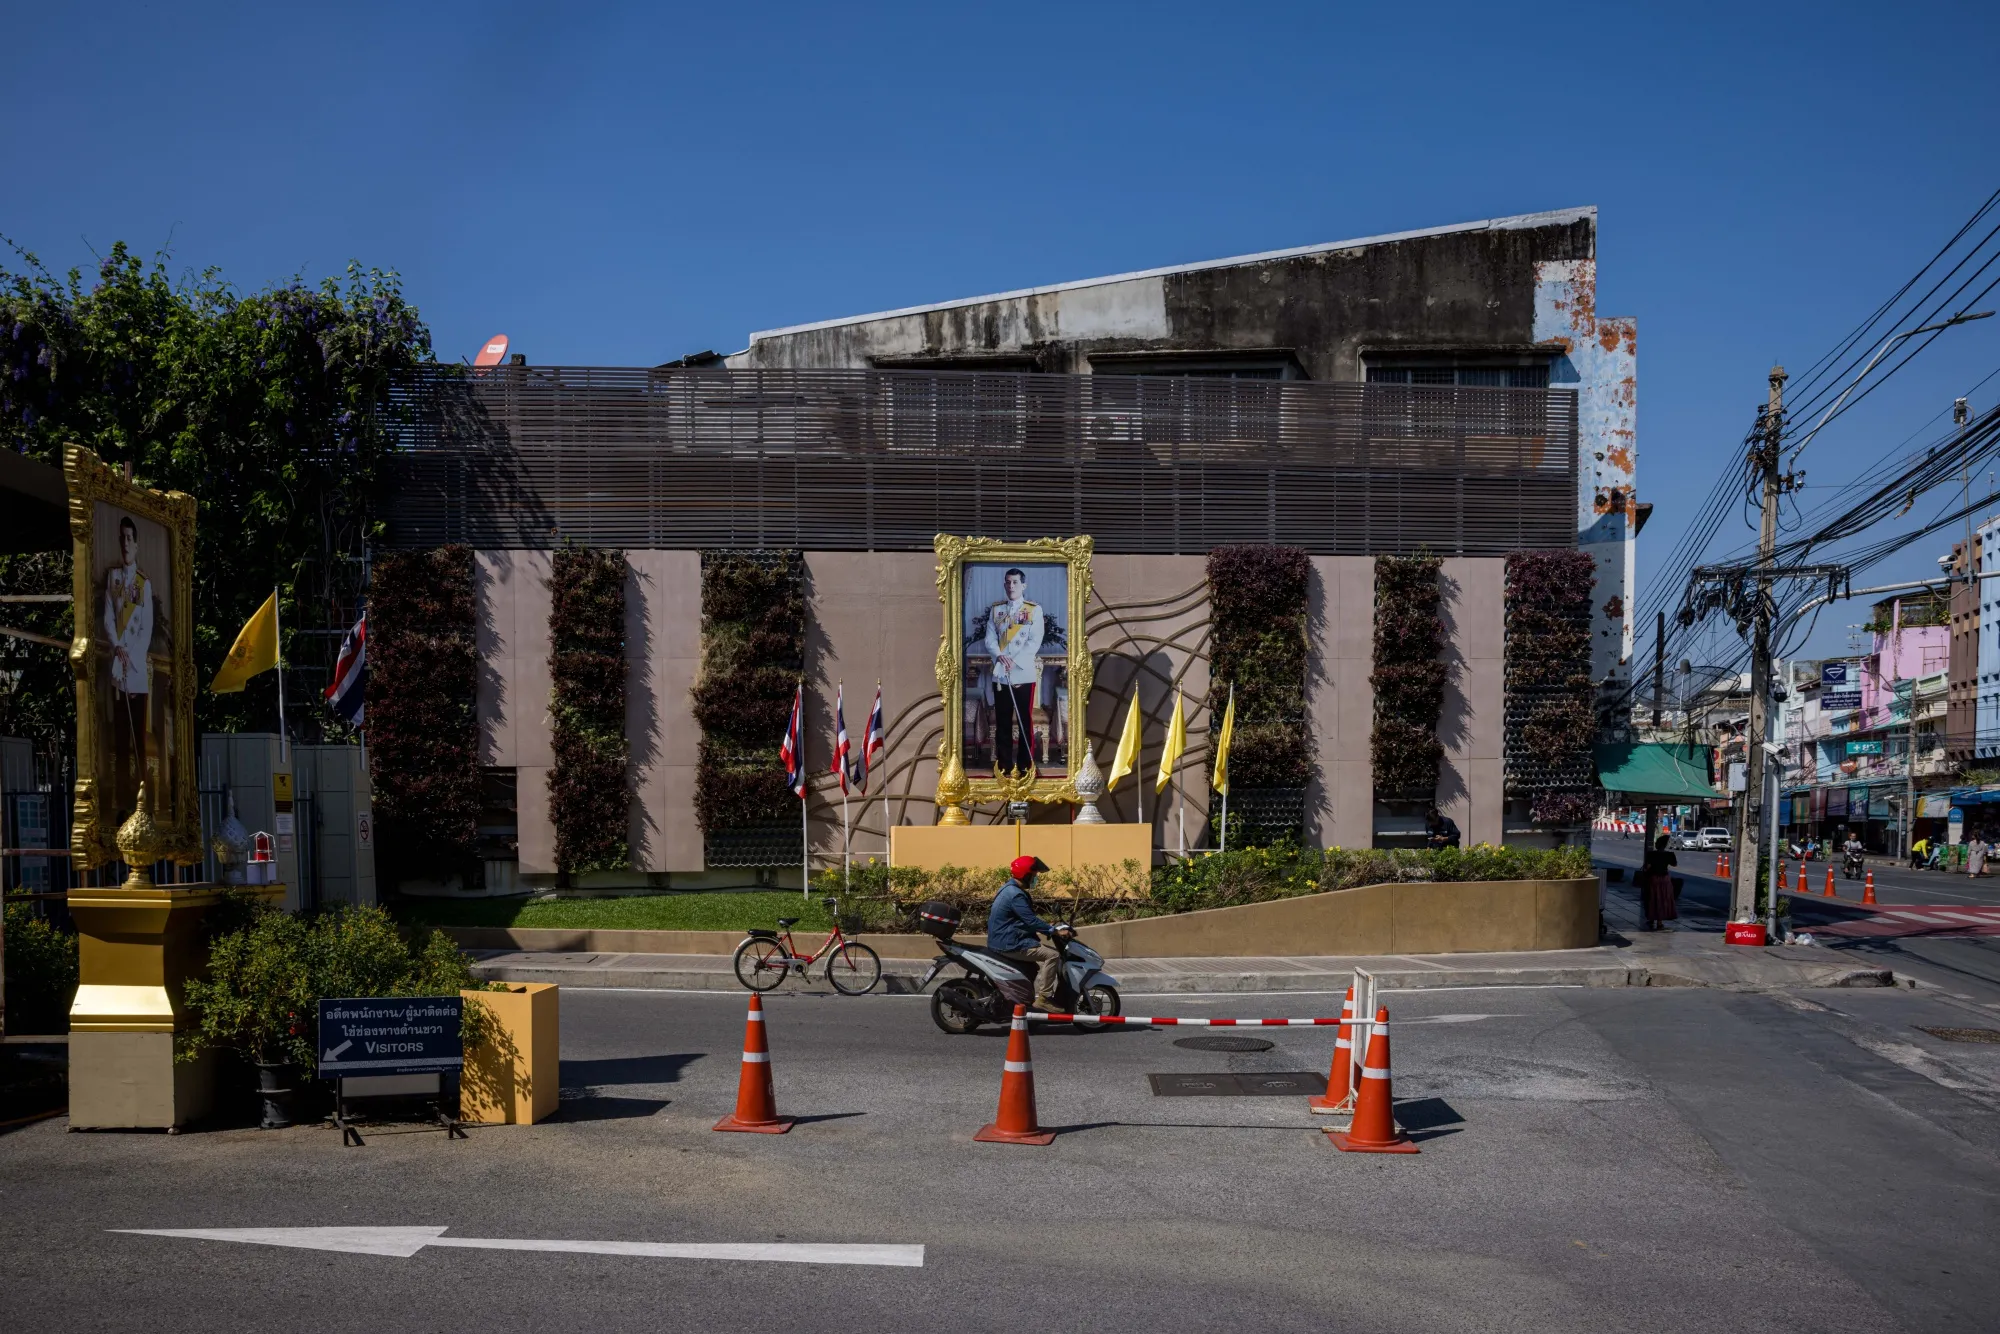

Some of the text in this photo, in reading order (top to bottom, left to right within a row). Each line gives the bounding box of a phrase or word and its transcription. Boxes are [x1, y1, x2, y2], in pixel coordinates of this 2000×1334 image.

[326, 1005, 458, 1021] อดีตพนักงาน/ผู้มาติดต่อ
[341, 1023, 443, 1037] ใช้ช่องทางด้านขวา
[365, 1041, 424, 1053] VISITORS
